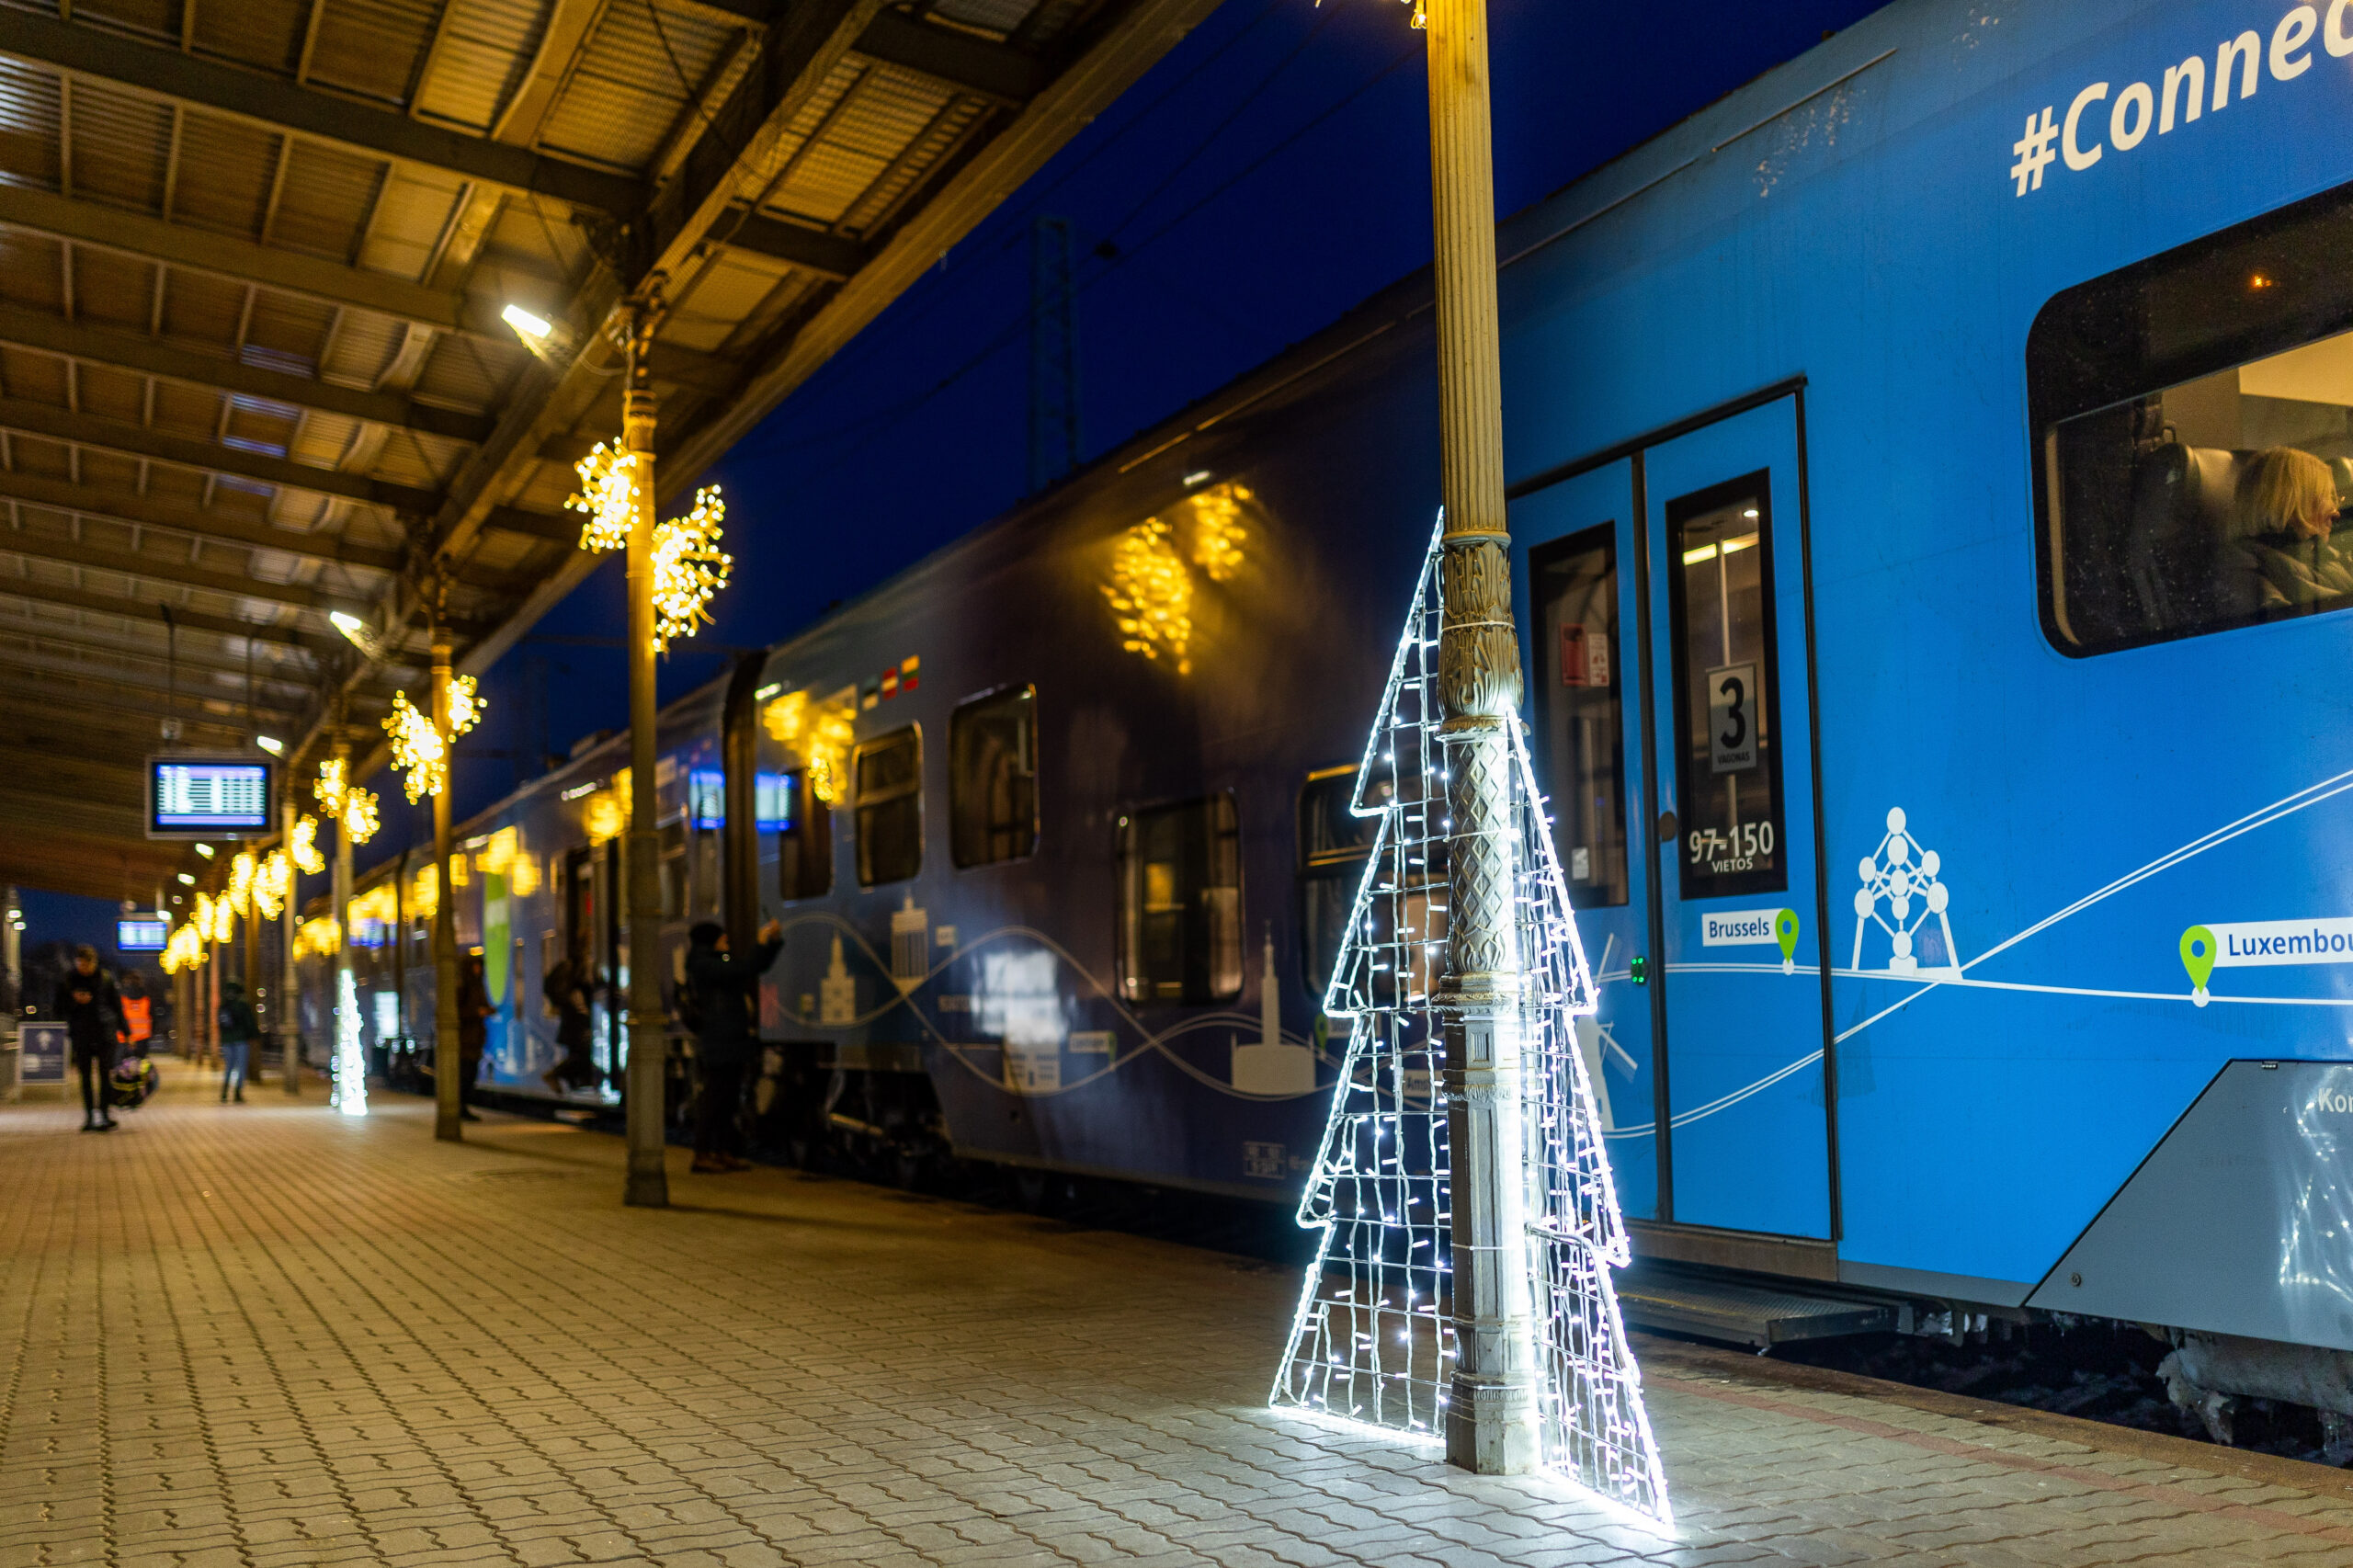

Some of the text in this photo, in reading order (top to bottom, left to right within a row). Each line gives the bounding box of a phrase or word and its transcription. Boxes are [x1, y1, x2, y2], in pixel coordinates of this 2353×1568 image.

[1720, 677, 1746, 749] 3
[1716, 751, 1751, 765] VAGONAS
[1689, 821, 1774, 864] 97-150
[1711, 857, 1753, 873] VIETOS
[1709, 917, 1769, 938] Brussels
